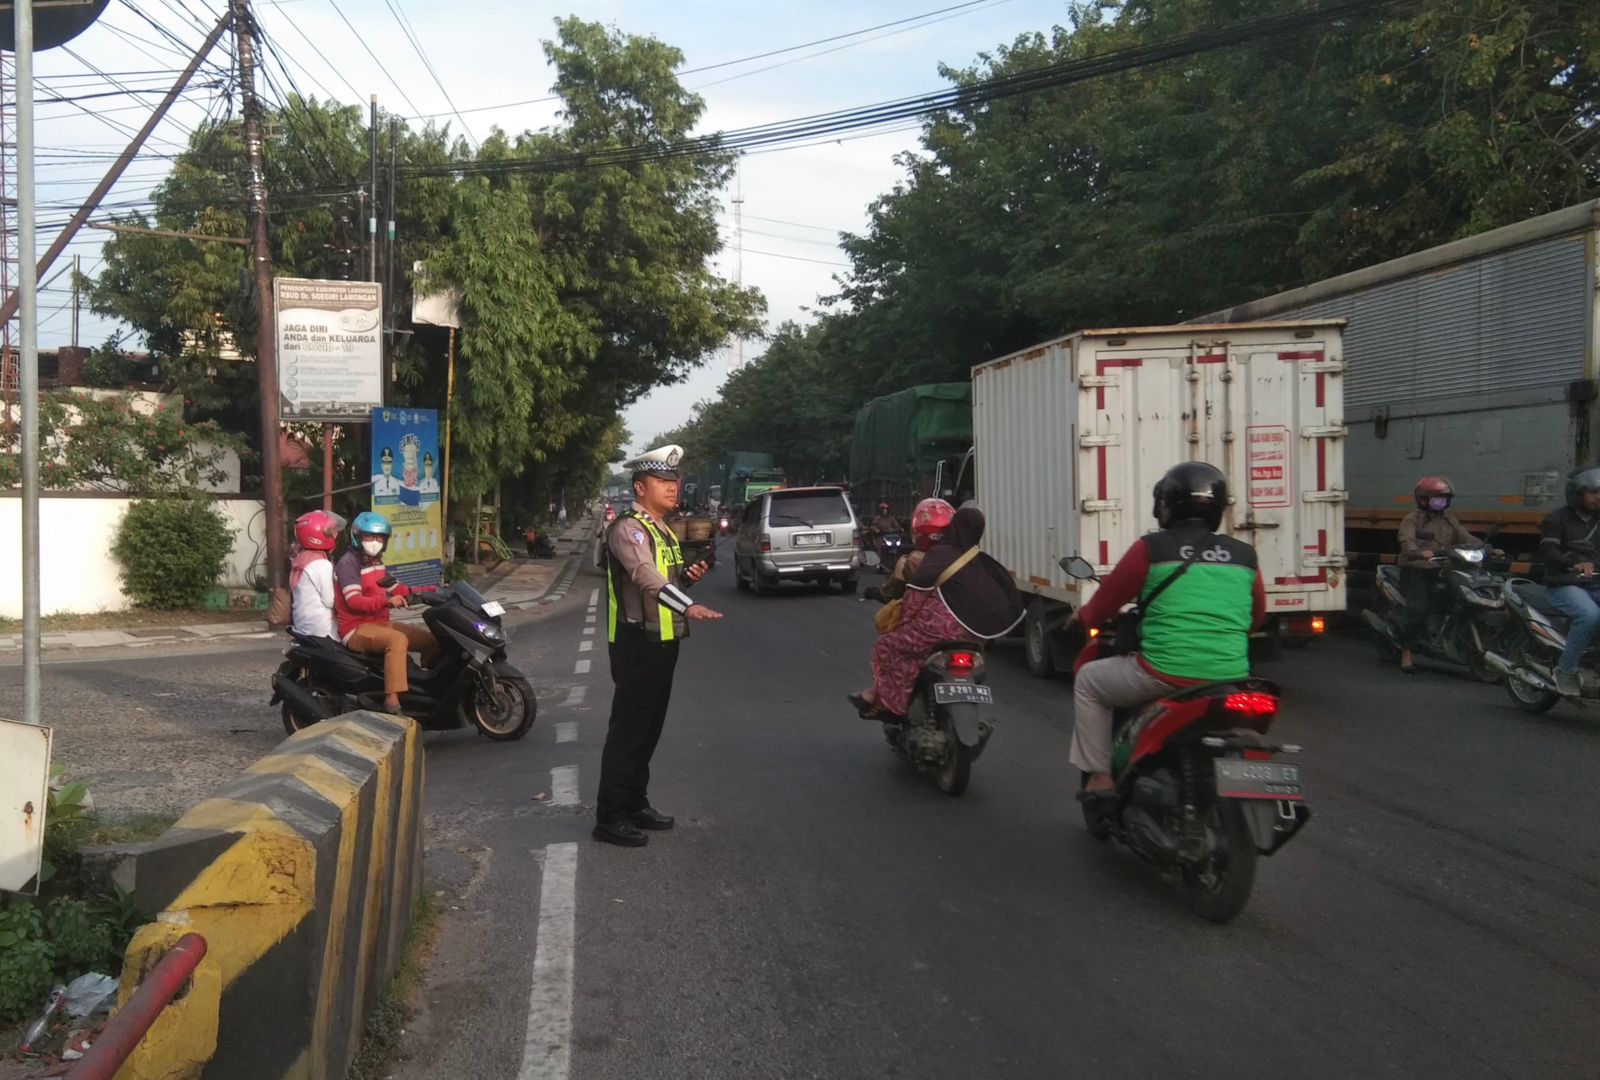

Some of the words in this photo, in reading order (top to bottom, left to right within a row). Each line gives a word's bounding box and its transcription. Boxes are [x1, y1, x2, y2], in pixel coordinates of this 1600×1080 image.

[283, 324, 307, 332] JAGA
[310, 325, 328, 333] DIRI
[311, 334, 326, 342] dan
[283, 342, 301, 350] dari
[1179, 544, 1231, 562] Gab
